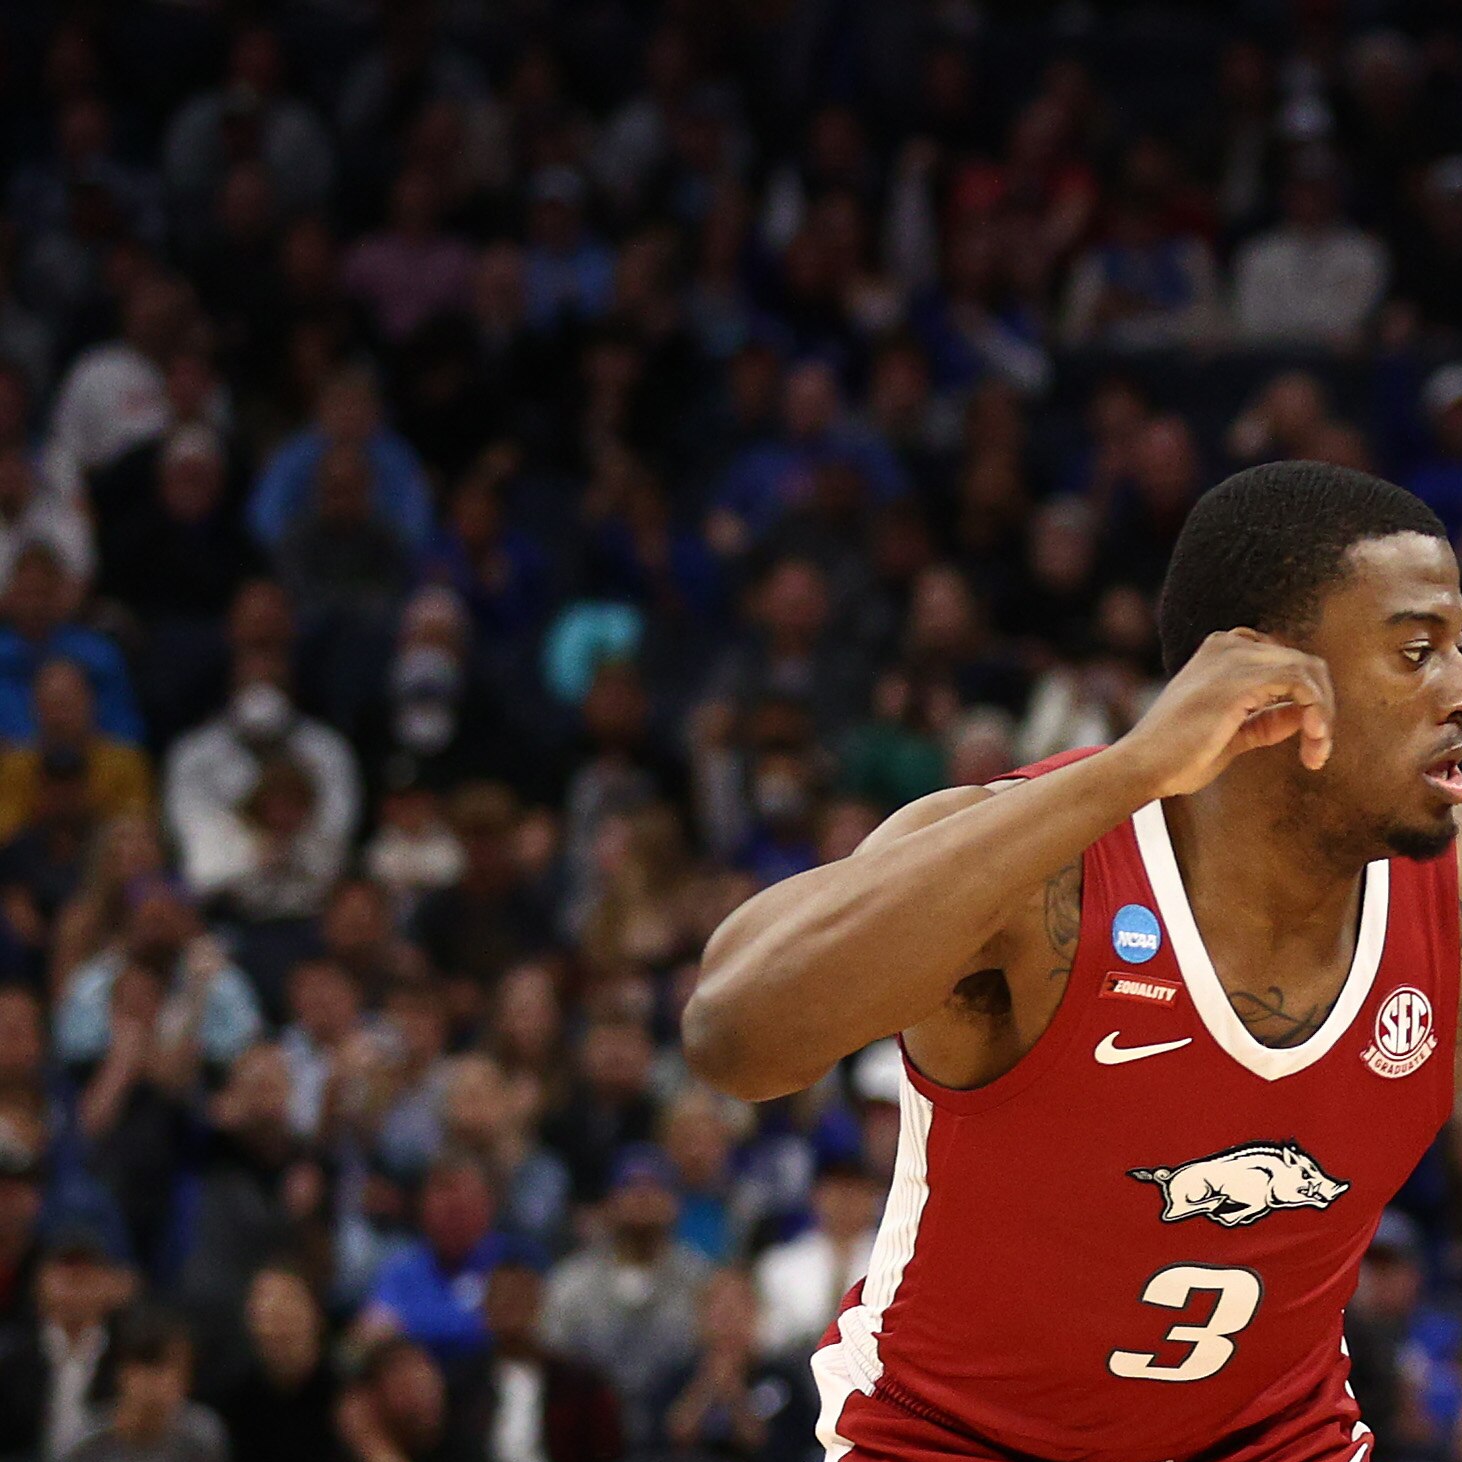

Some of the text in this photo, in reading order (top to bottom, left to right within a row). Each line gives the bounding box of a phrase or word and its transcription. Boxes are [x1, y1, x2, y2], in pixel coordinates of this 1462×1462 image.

[1118, 930, 1157, 949] NCAA
[1113, 979, 1177, 1001] EQUALITY
[1381, 993, 1428, 1054] SEC
[1374, 1050, 1426, 1075] GRADUATE
[1108, 1262, 1262, 1382] 3
